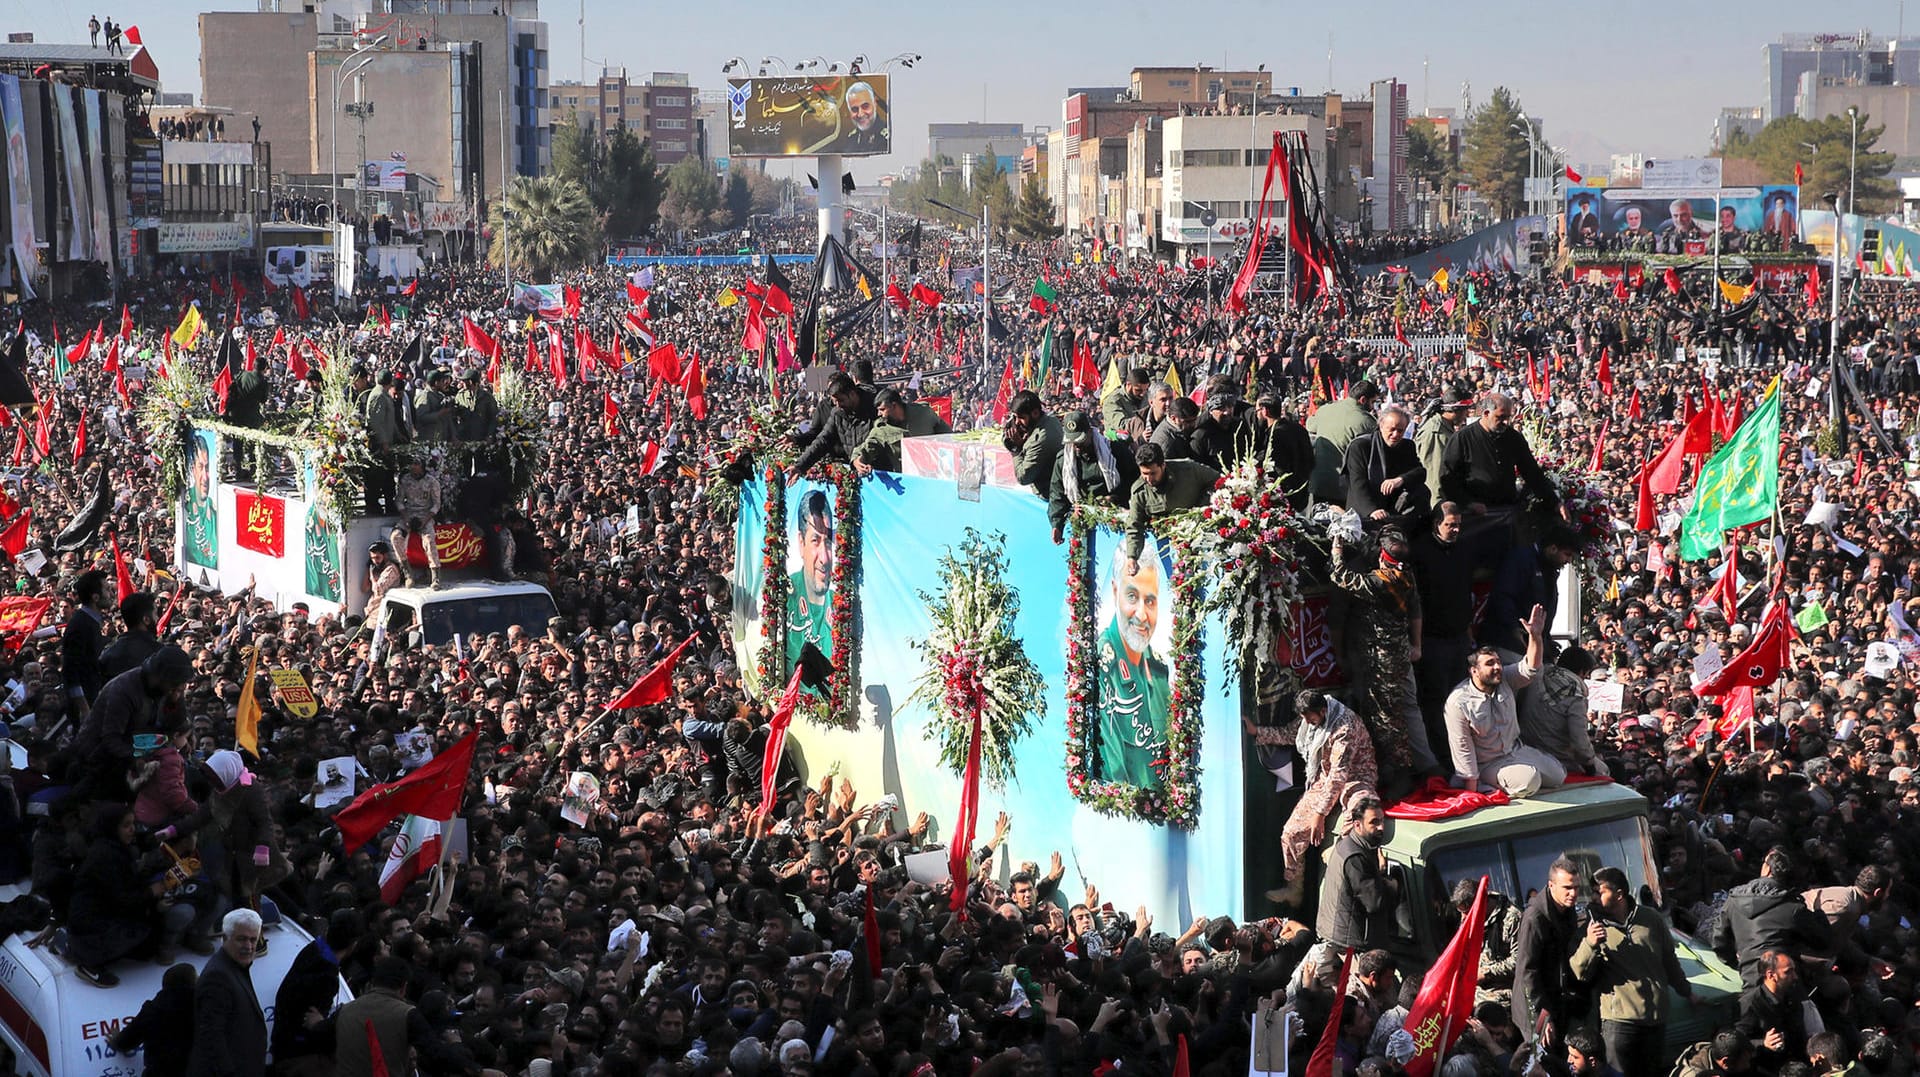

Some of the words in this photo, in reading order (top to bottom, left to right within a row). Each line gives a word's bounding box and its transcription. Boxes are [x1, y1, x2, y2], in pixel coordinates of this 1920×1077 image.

[1814, 32, 1856, 44] رستوران
[285, 691, 312, 702] USA
[1099, 677, 1144, 709] سلیمانی
[1107, 702, 1144, 737] قاسم
[1135, 722, 1153, 747] حاج
